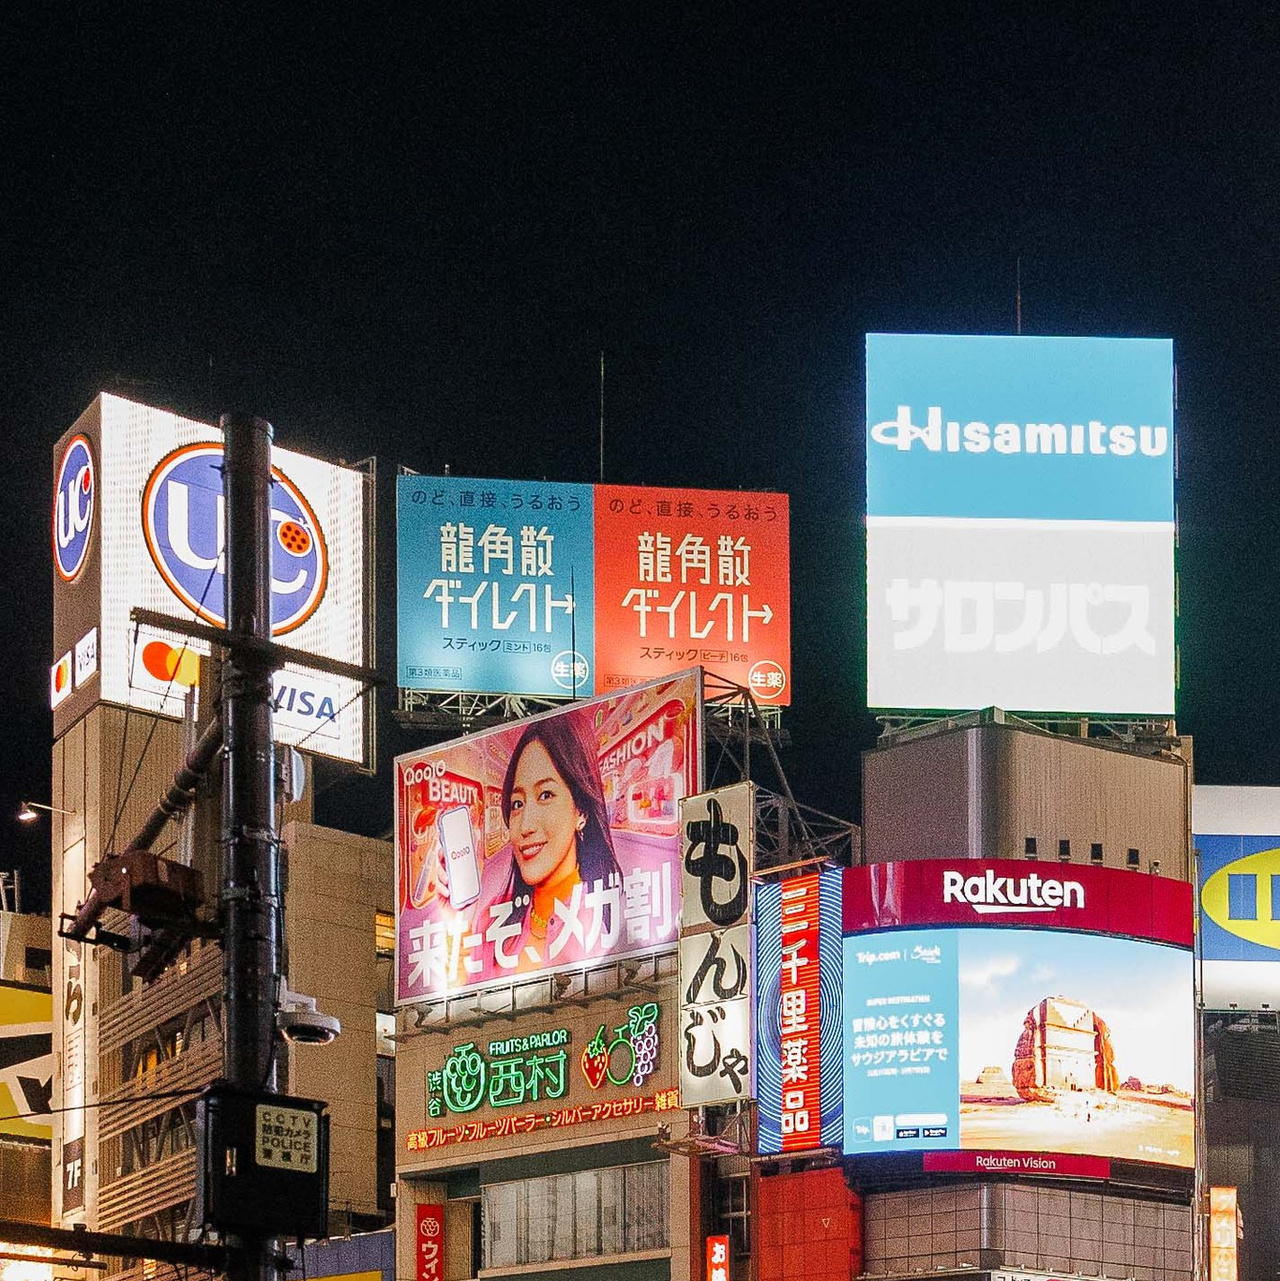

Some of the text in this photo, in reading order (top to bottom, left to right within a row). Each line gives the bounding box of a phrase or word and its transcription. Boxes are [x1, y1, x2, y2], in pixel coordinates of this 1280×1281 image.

[871, 405, 1168, 457] Hisamitsu
[411, 489, 581, 512] のど、直接、うるおう
[609, 498, 778, 522] のど、直接、うるおう
[440, 522, 554, 577] 龍角散
[638, 532, 752, 587] 龍角散
[423, 579, 576, 633] ダイレクト
[621, 589, 774, 644] ダイレクト
[885, 578, 1157, 656] サロンパス
[443, 637, 501, 654] スティック
[504, 641, 531, 654] ミント
[640, 647, 699, 663] スティック
[702, 651, 727, 663] ピーチ
[553, 661, 587, 681] 生薬
[751, 671, 784, 689] 生薬
[274, 685, 336, 723] VISA
[429, 778, 480, 804] BEAUTY
[943, 869, 1085, 910] Rakuten
[685, 798, 750, 1096] もんじゃ
[857, 951, 901, 966] Trip.com
[781, 887, 809, 1135] 三千里薬品
[489, 1028, 568, 1056] FRUITS&PARLOR
[851, 1047, 948, 1068] サウジアラビアで
[428, 1070, 443, 1118] 渋谷
[489, 1049, 567, 1108] 西村
[262, 1135, 311, 1153] POLICE
[66, 1158, 82, 1190] 7F
[976, 1155, 1056, 1170] Rakuten Vision
